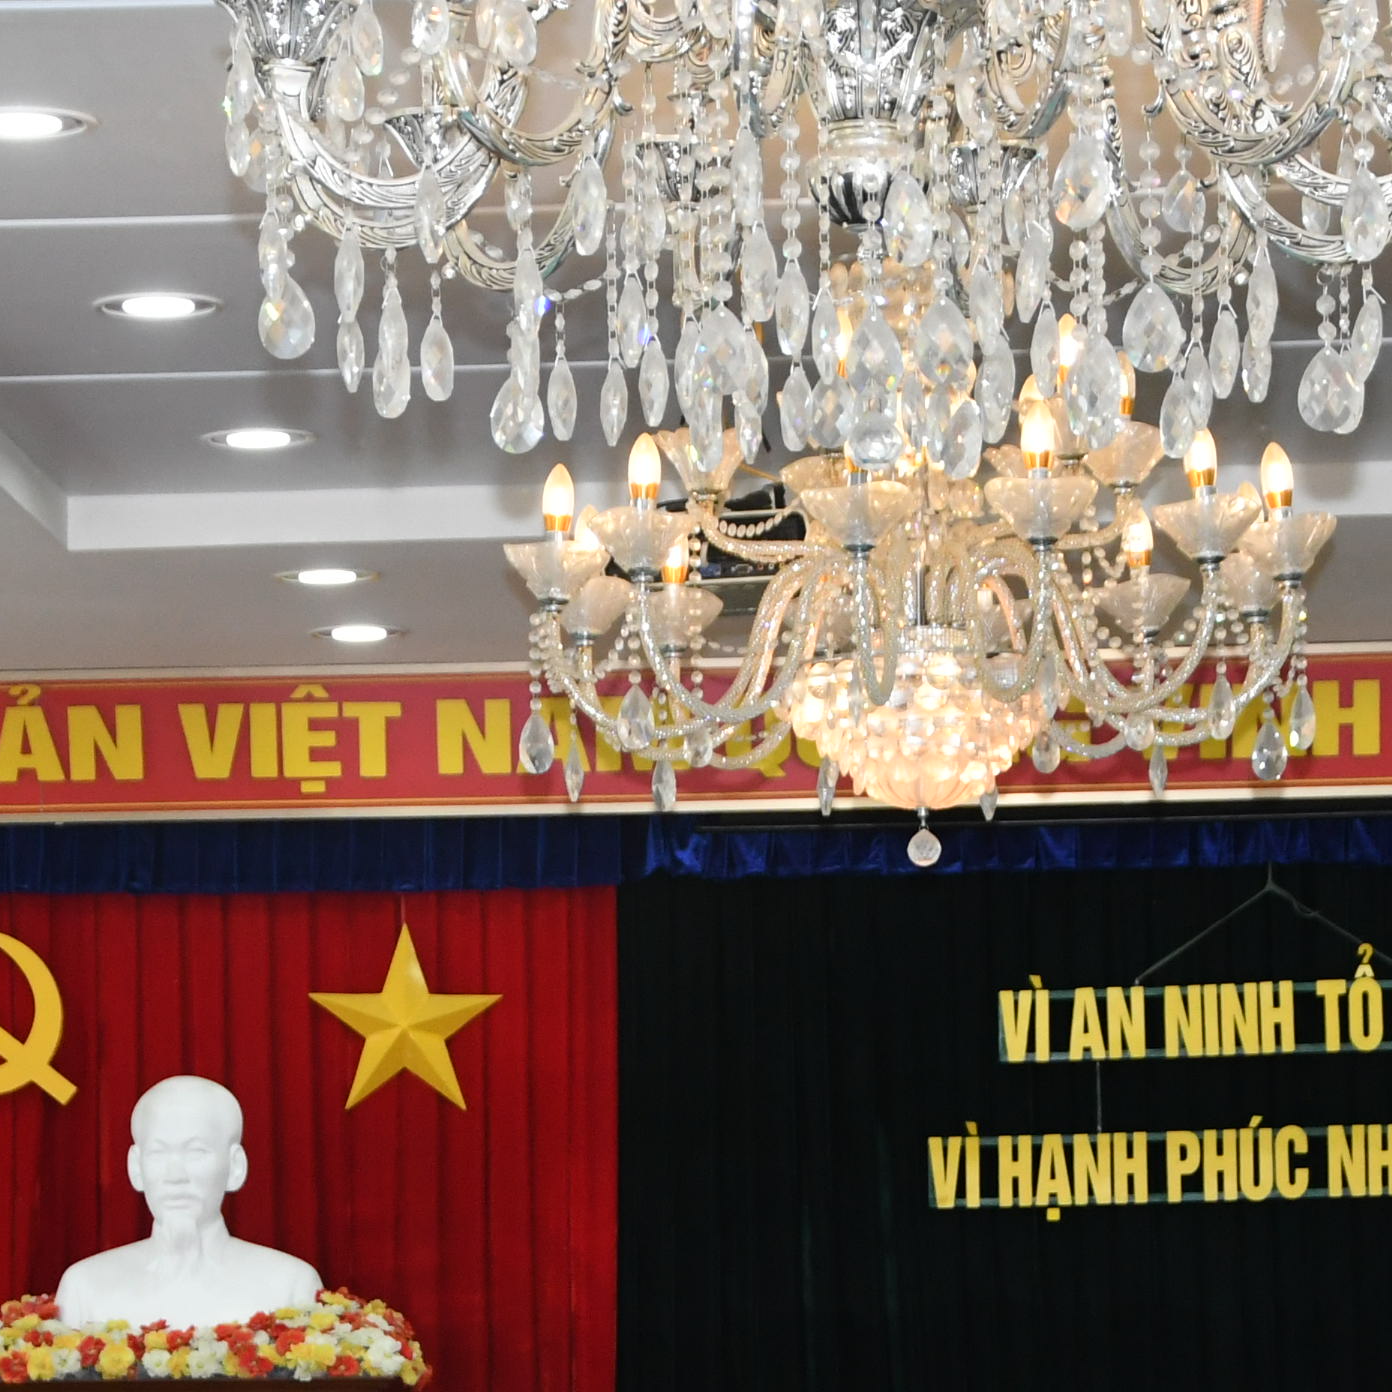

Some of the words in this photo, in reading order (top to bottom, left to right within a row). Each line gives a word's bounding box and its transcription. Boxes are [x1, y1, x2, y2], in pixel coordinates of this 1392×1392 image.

[178, 684, 402, 793] VIỆT
[998, 974, 1051, 1063] VÌ
[1068, 985, 1147, 1061] AN
[1163, 979, 1296, 1058] NINH
[1315, 943, 1384, 1053] TỔ
[927, 1121, 982, 1209] VÌ
[997, 1131, 1149, 1221] HẠNH
[1165, 1115, 1310, 1203] PHÚC
